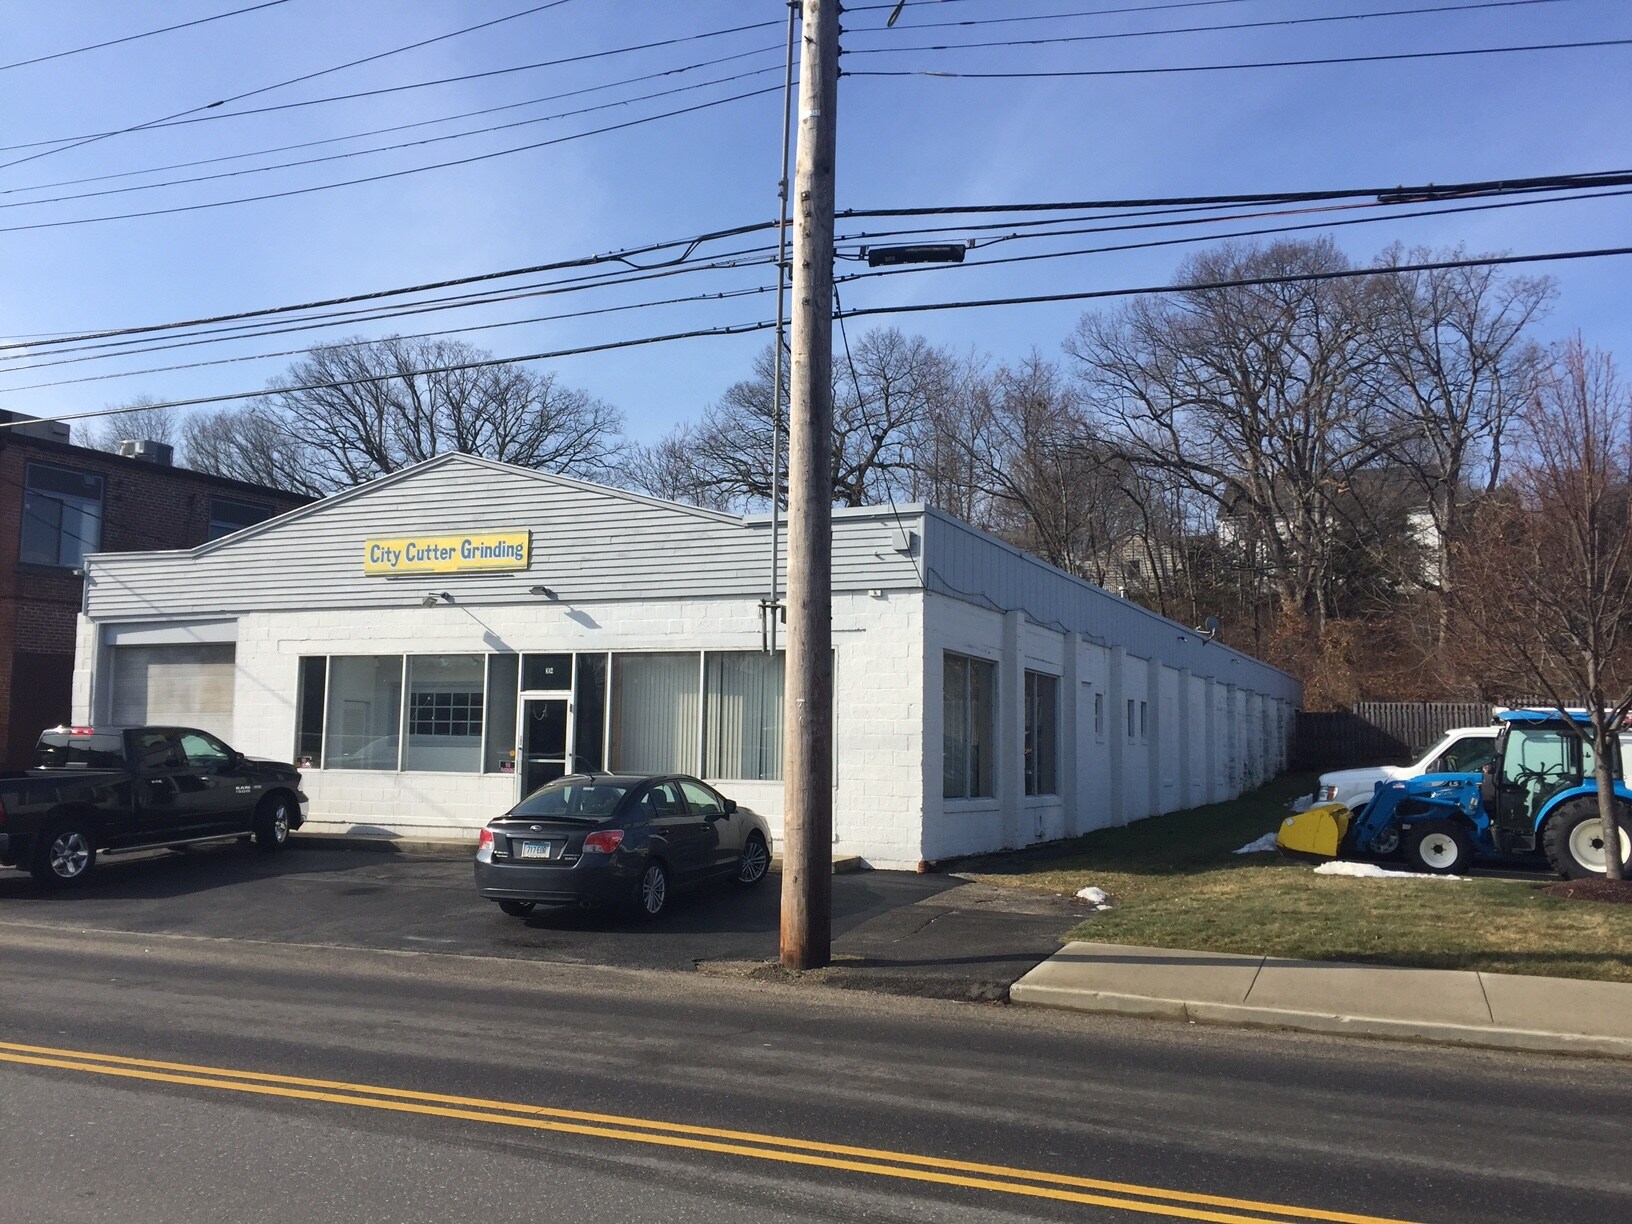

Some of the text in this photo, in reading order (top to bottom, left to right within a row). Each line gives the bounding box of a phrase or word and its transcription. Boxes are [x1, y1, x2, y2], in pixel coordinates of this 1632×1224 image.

[370, 539, 524, 567] City Cutter Grinding
